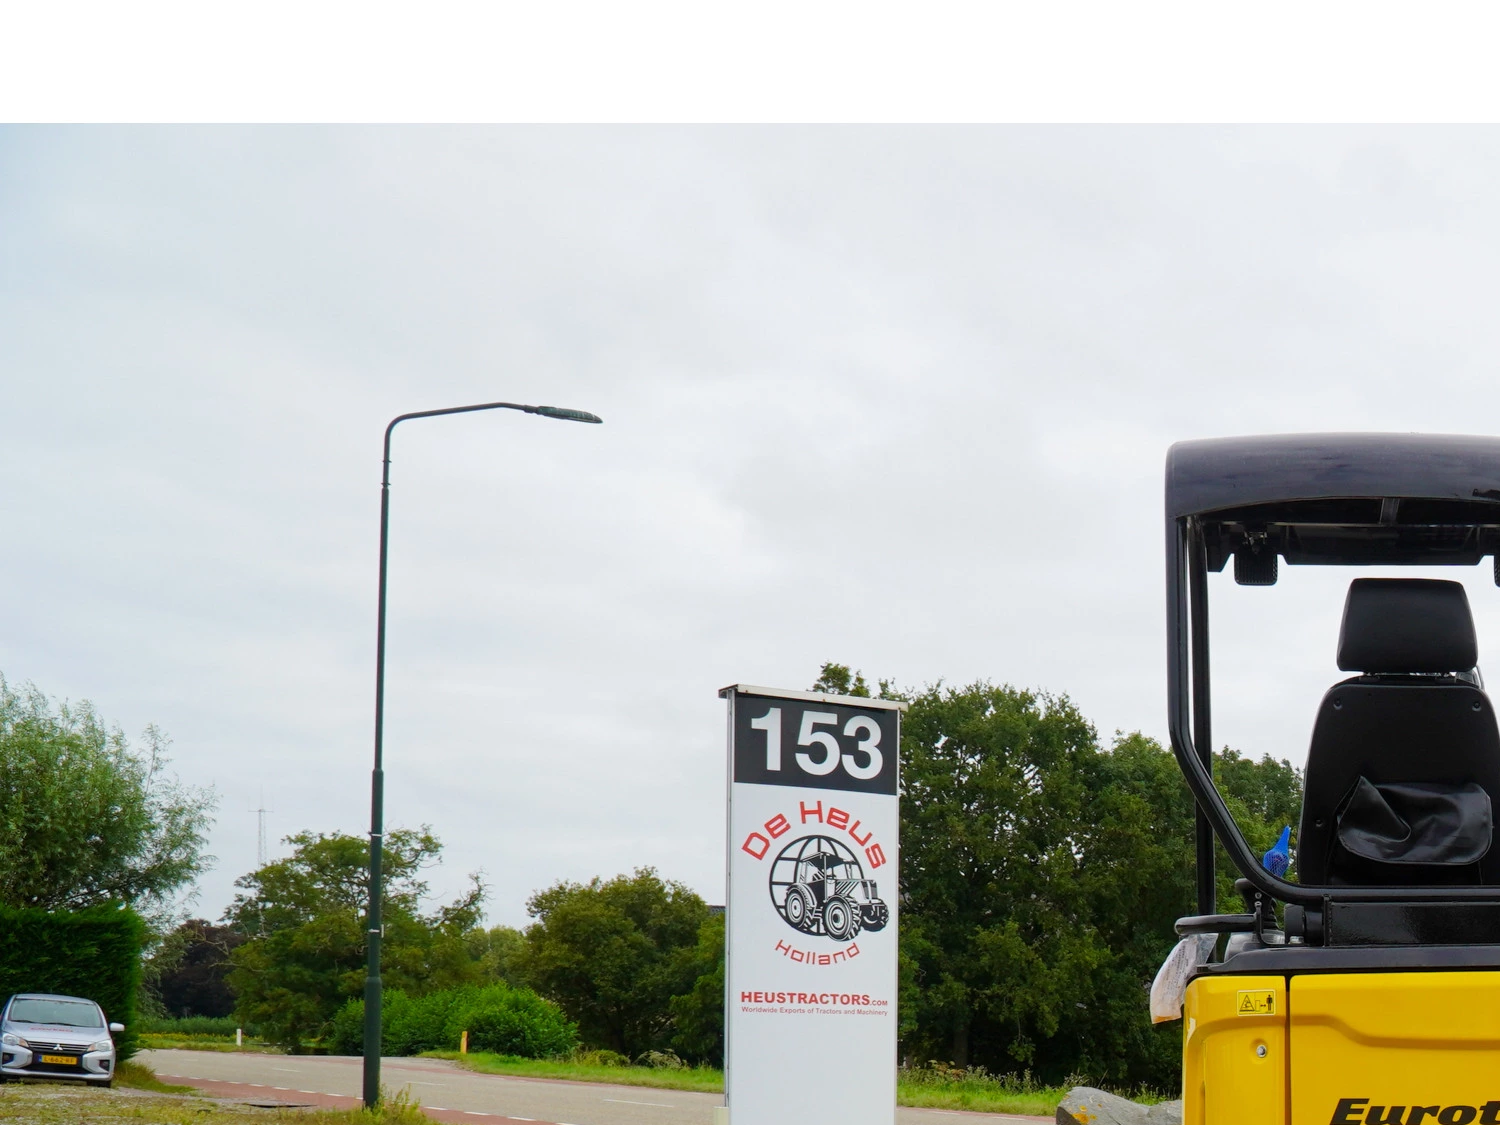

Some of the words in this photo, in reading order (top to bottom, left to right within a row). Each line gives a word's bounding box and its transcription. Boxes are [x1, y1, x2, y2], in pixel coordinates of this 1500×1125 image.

[751, 707, 884, 780] 153
[741, 812, 792, 861] De
[799, 799, 887, 870] Heus
[775, 939, 861, 966] Holland
[740, 991, 888, 1006] HEUSTRACTORS.COM
[741, 1006, 778, 1014] Worldwide
[779, 1007, 806, 1015] Exports
[857, 1009, 888, 1017] Machinery
